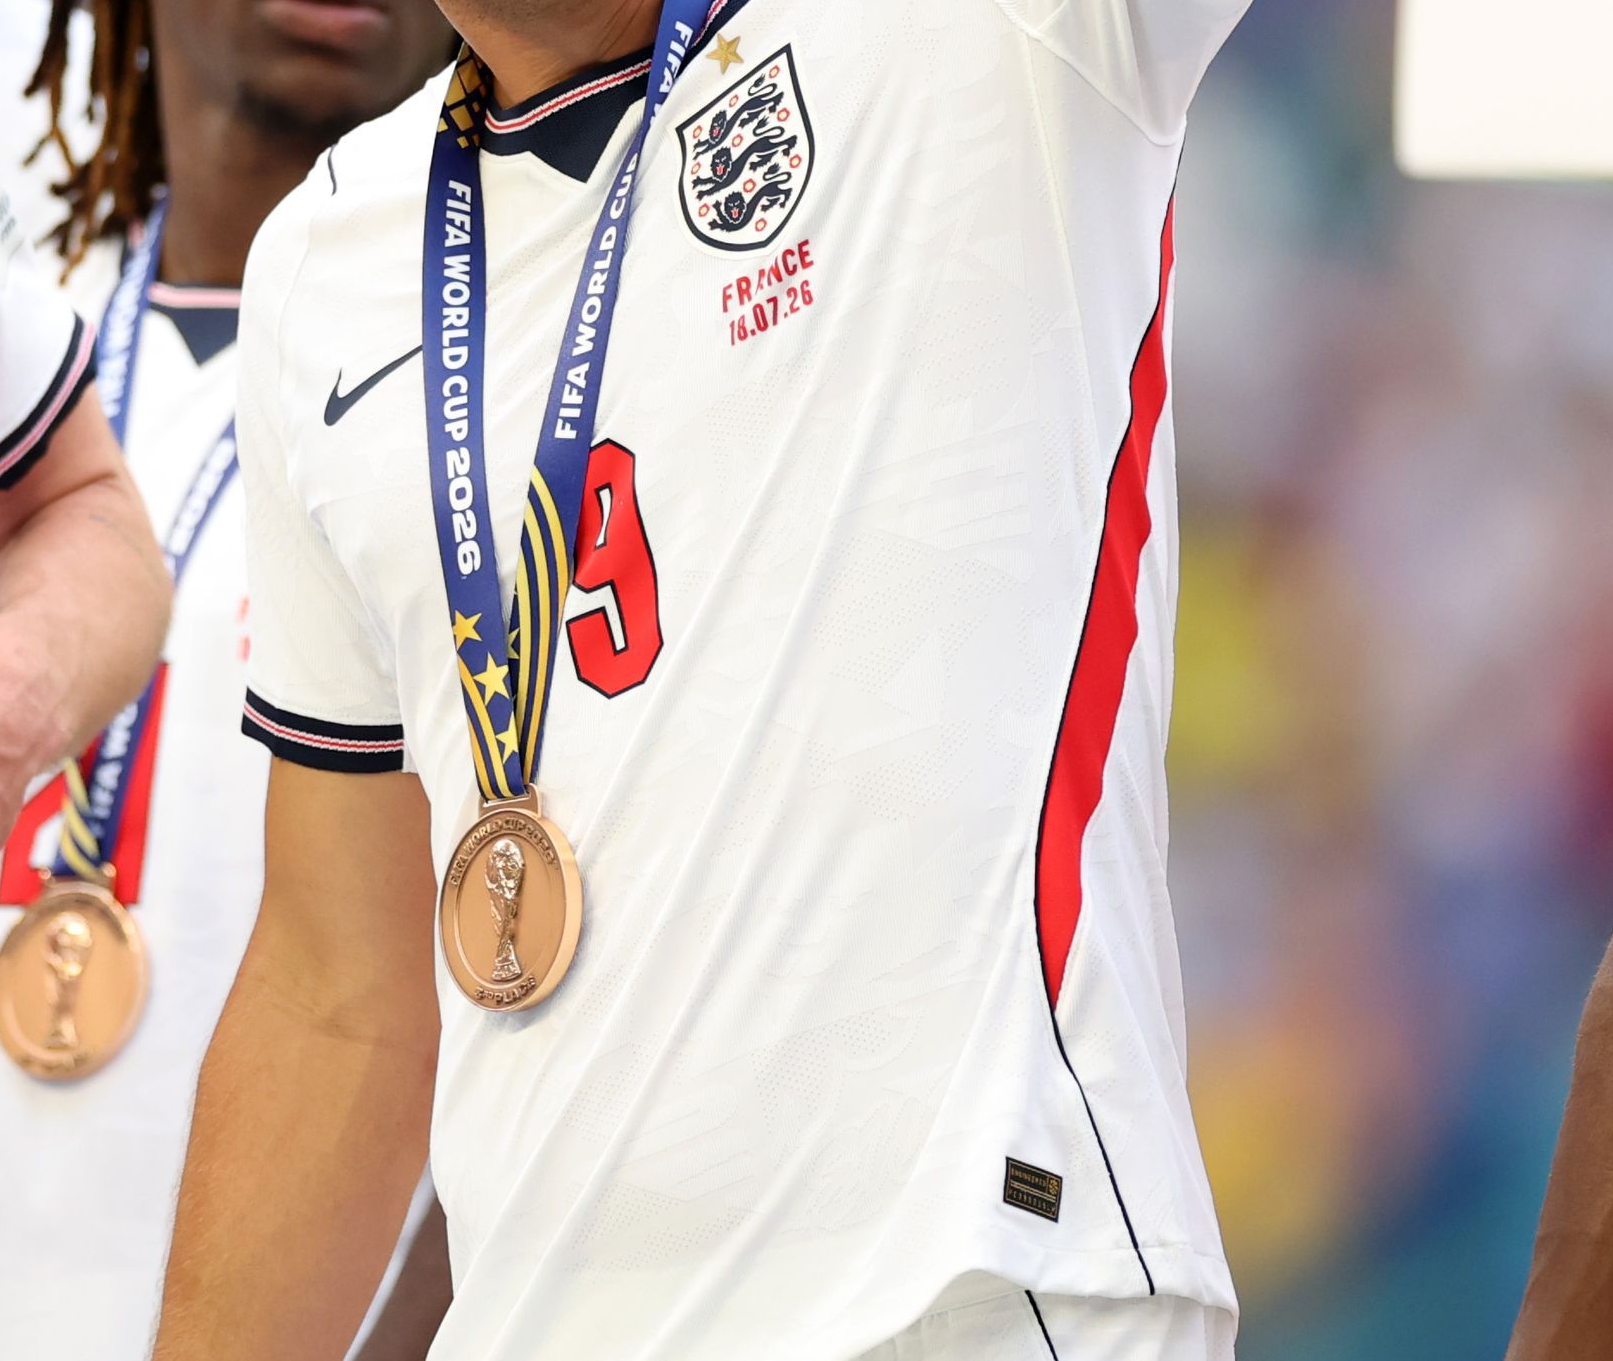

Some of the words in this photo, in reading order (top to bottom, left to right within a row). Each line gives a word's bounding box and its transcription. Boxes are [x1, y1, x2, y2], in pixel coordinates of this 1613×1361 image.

[659, 21, 694, 93] FIFA
[444, 179, 475, 248] FIFA
[441, 251, 472, 371] WORLD
[555, 362, 589, 440] FIFA
[574, 225, 618, 358] WORLD
[610, 151, 639, 223] CUP
[721, 238, 815, 313] FRANCE
[729, 280, 815, 346] 18.07.26
[442, 373, 470, 443] CUP
[446, 454, 482, 576] 2026
[566, 437, 664, 699] 9
